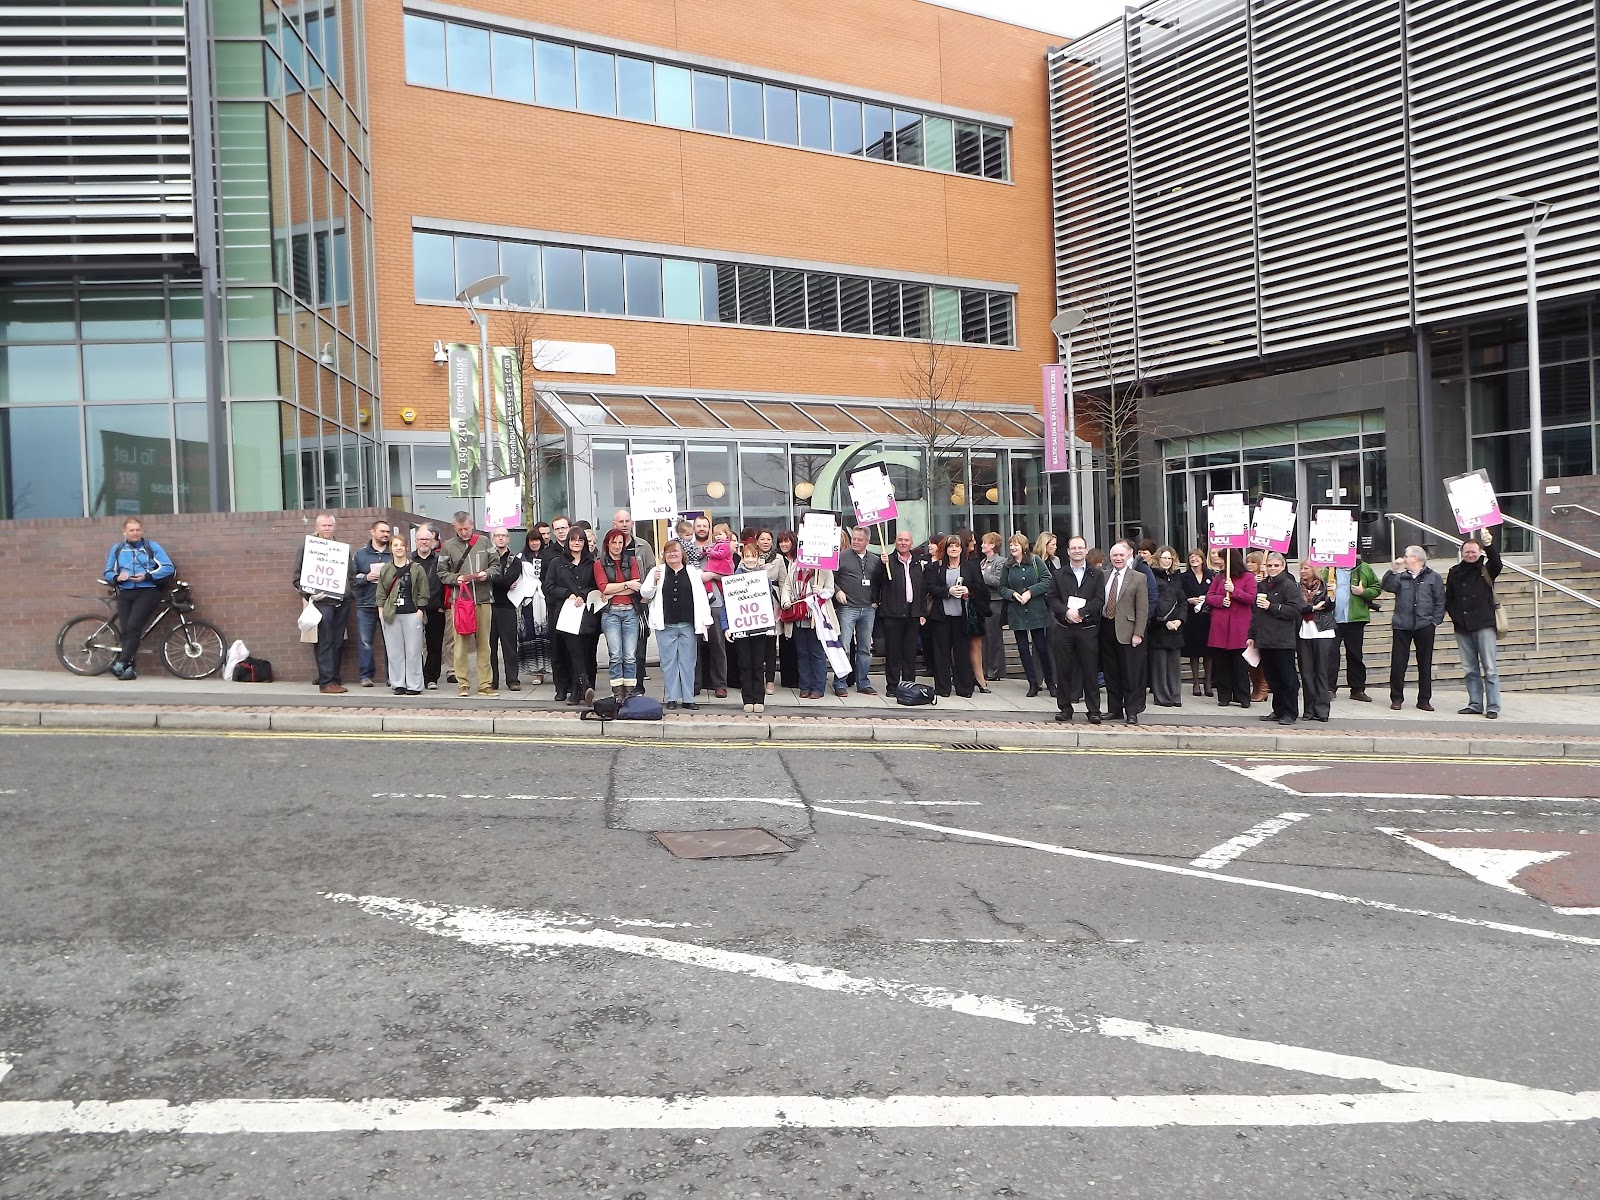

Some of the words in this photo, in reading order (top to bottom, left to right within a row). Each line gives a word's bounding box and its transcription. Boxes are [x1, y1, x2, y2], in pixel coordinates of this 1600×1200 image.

[455, 356, 466, 413] greenhouse
[458, 421, 467, 442] 2414
[459, 447, 467, 463] 490
[460, 469, 468, 489] 0191
[315, 564, 334, 576] NO
[307, 574, 340, 589] CUTS
[740, 602, 760, 615] NO
[734, 614, 769, 628] CUTS
